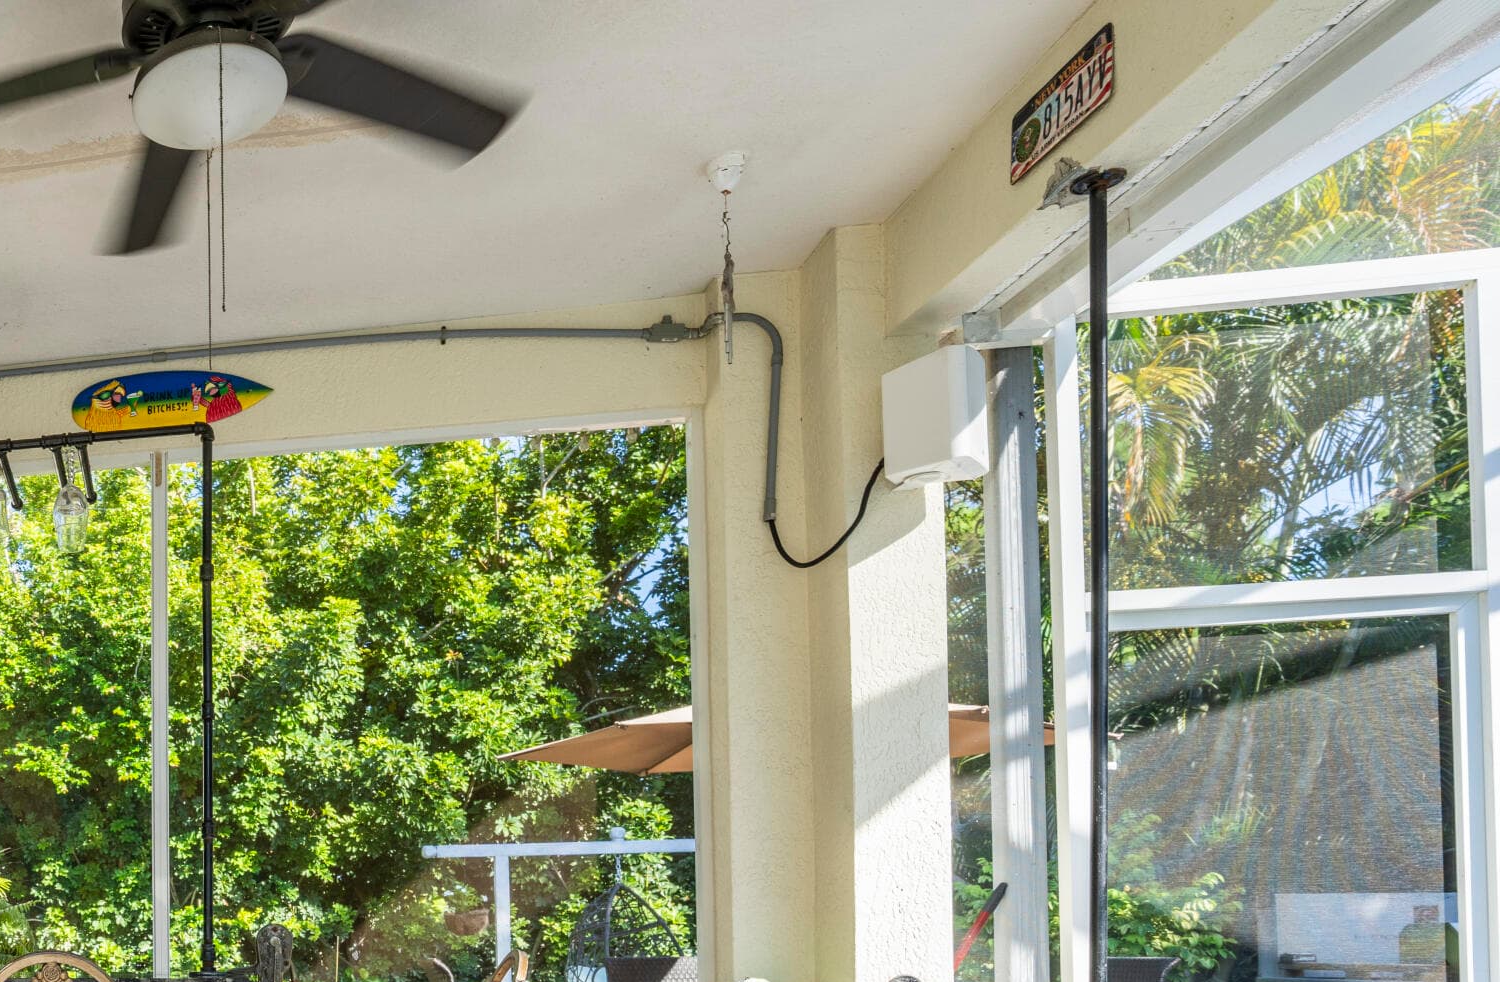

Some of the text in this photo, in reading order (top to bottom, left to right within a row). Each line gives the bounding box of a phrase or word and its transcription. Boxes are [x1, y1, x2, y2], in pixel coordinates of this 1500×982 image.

[1035, 55, 1085, 109] NEW YORK
[1043, 50, 1108, 140] 815AYV
[144, 390, 173, 403] DRINK
[147, 402, 188, 415] BITCHES!!
